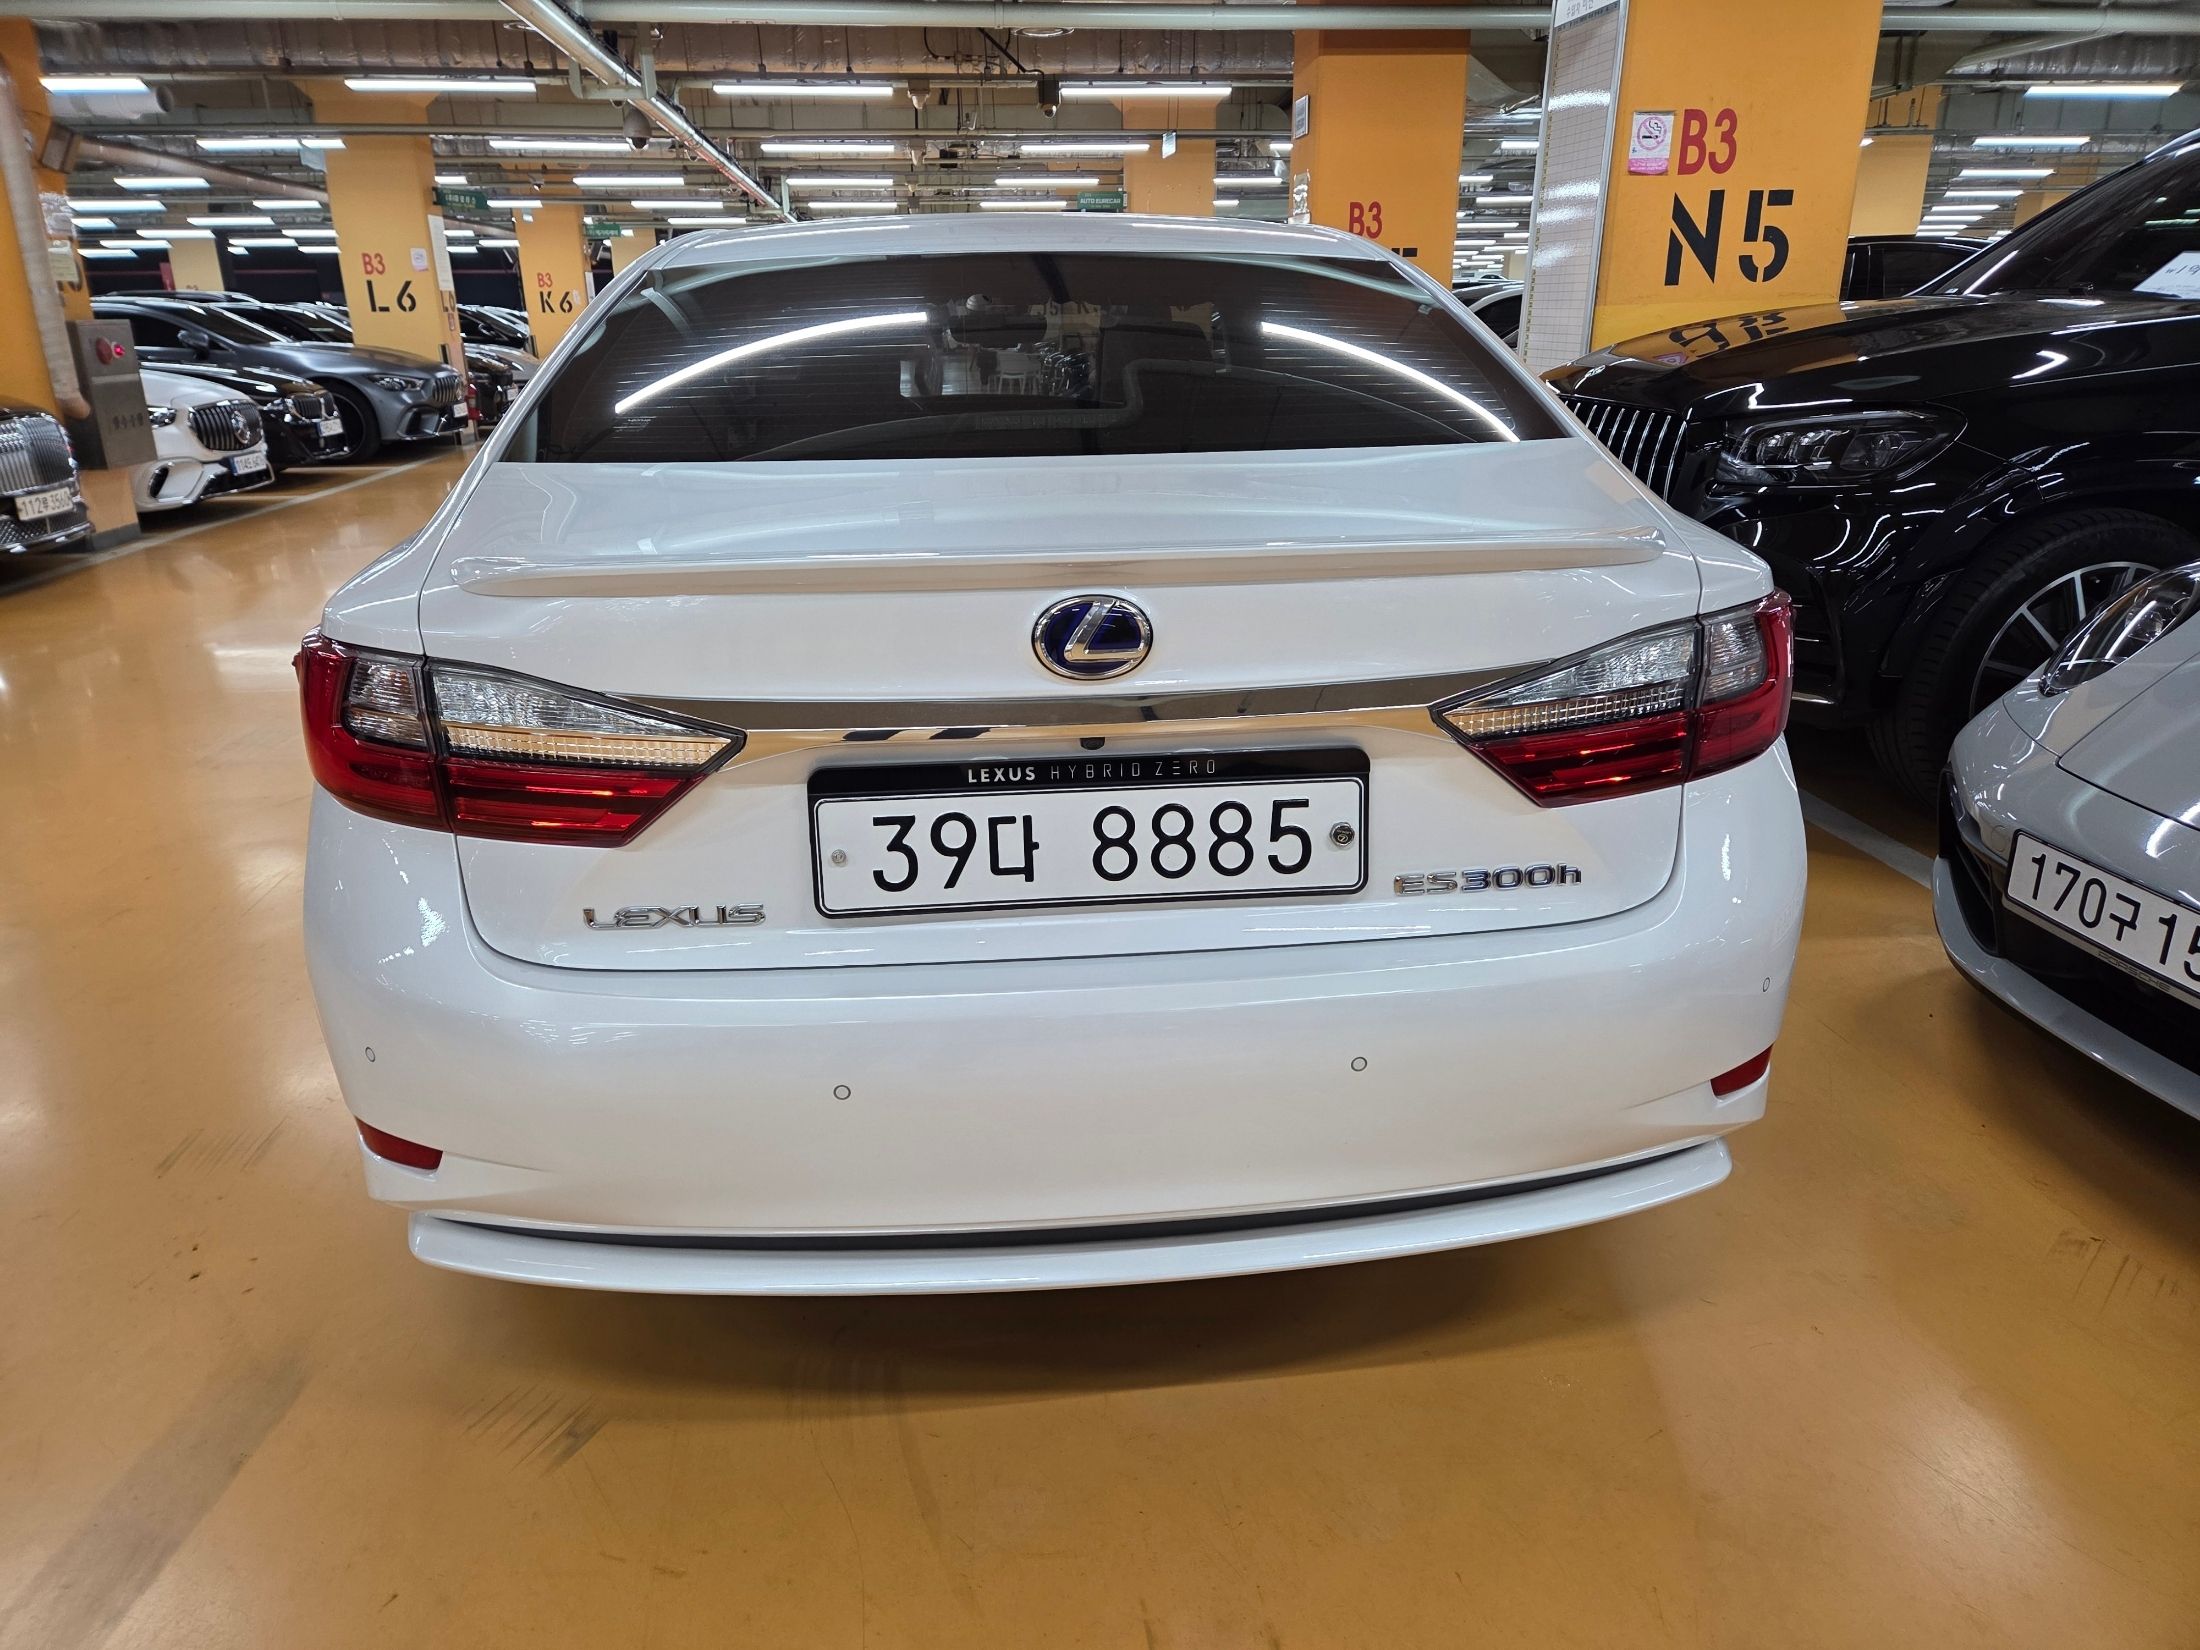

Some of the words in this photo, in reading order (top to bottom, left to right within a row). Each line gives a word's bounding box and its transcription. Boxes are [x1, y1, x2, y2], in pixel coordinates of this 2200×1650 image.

[1677, 108, 1738, 175] B3
[1349, 201, 1383, 239] B3
[1664, 189, 1794, 286] N5
[362, 252, 386, 275] B3
[537, 272, 553, 288] B3
[366, 280, 417, 313] L6
[539, 291, 573, 314] K6
[968, 766, 1036, 783] LEXUS
[1050, 763, 1141, 780] HYBRID
[1154, 759, 1216, 776] ZERO
[872, 811, 1040, 892] 39다
[1092, 799, 1313, 882] 8885
[1394, 862, 1582, 896] ES300h
[2031, 853, 2142, 942] 170구
[583, 903, 767, 931] LEXUS
[2098, 950, 2172, 993] PORSCHE
